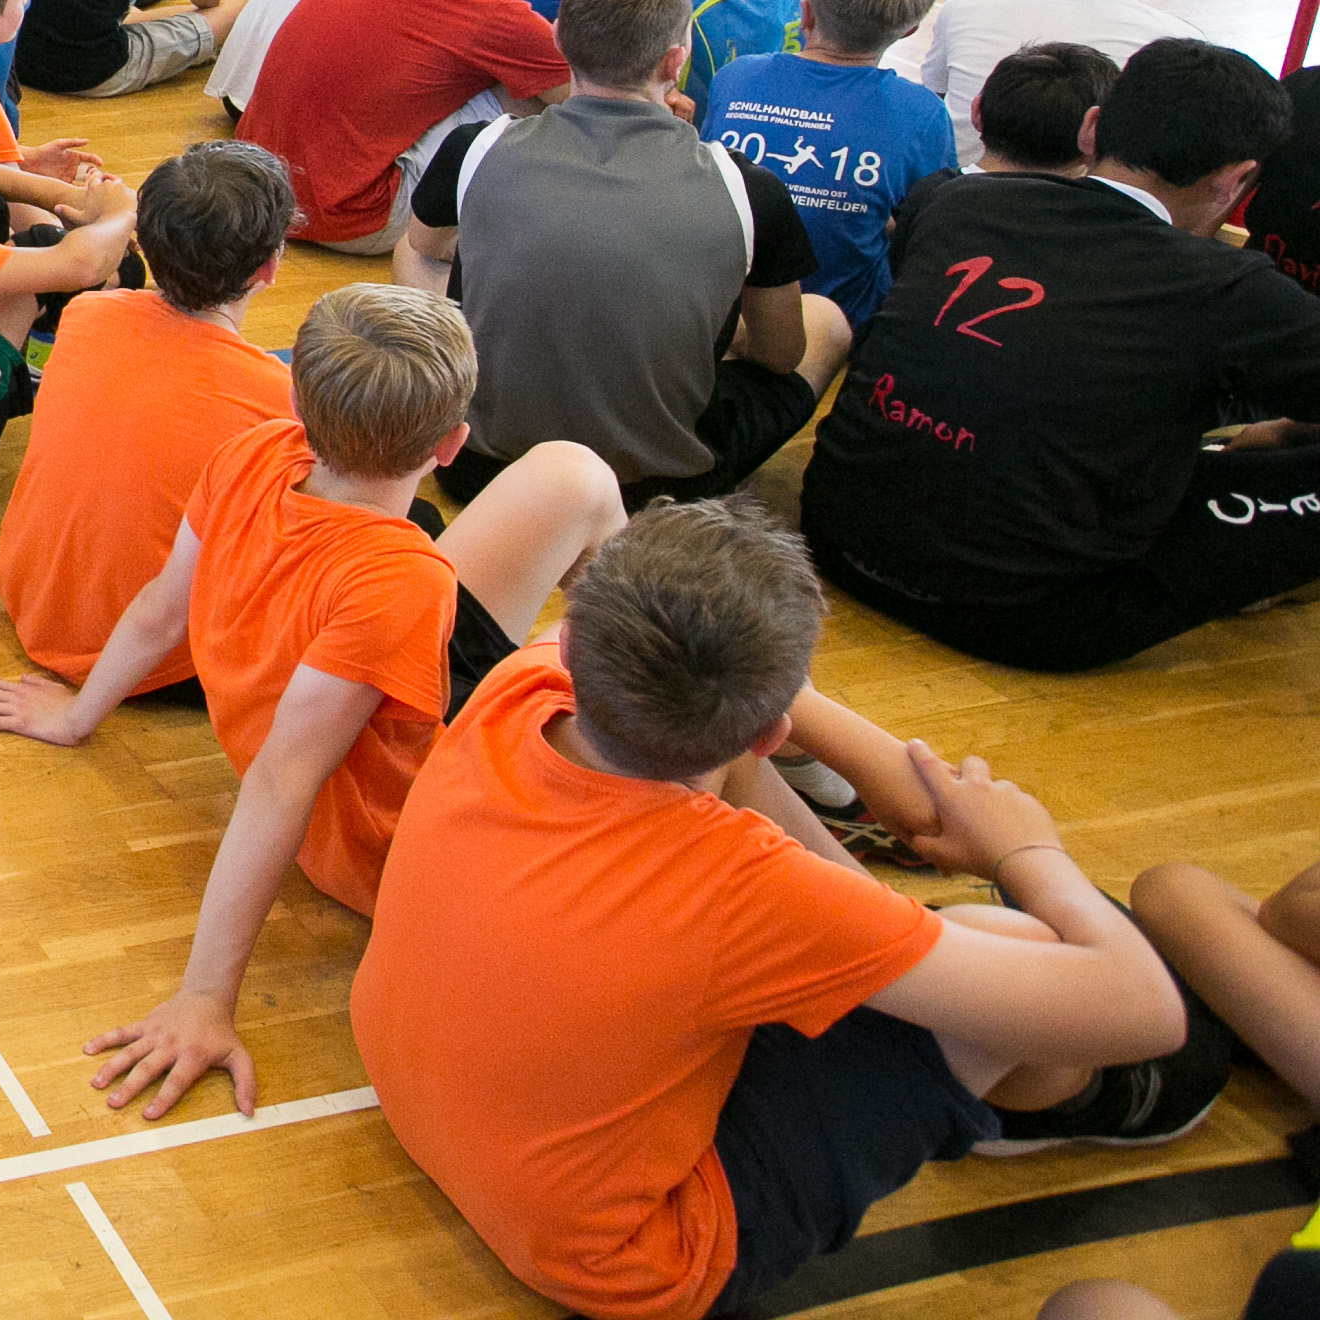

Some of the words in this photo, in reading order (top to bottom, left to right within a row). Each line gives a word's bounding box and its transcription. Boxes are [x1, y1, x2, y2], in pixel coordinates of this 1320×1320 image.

[725, 112, 769, 122] REGIONALES
[770, 116, 832, 131] FINALTURNIER
[728, 101, 835, 123] SCHULHANDBALL
[831, 146, 881, 187] 18
[831, 191, 848, 199] OST
[934, 256, 1046, 347] 12
[868, 373, 976, 452] Ramon
